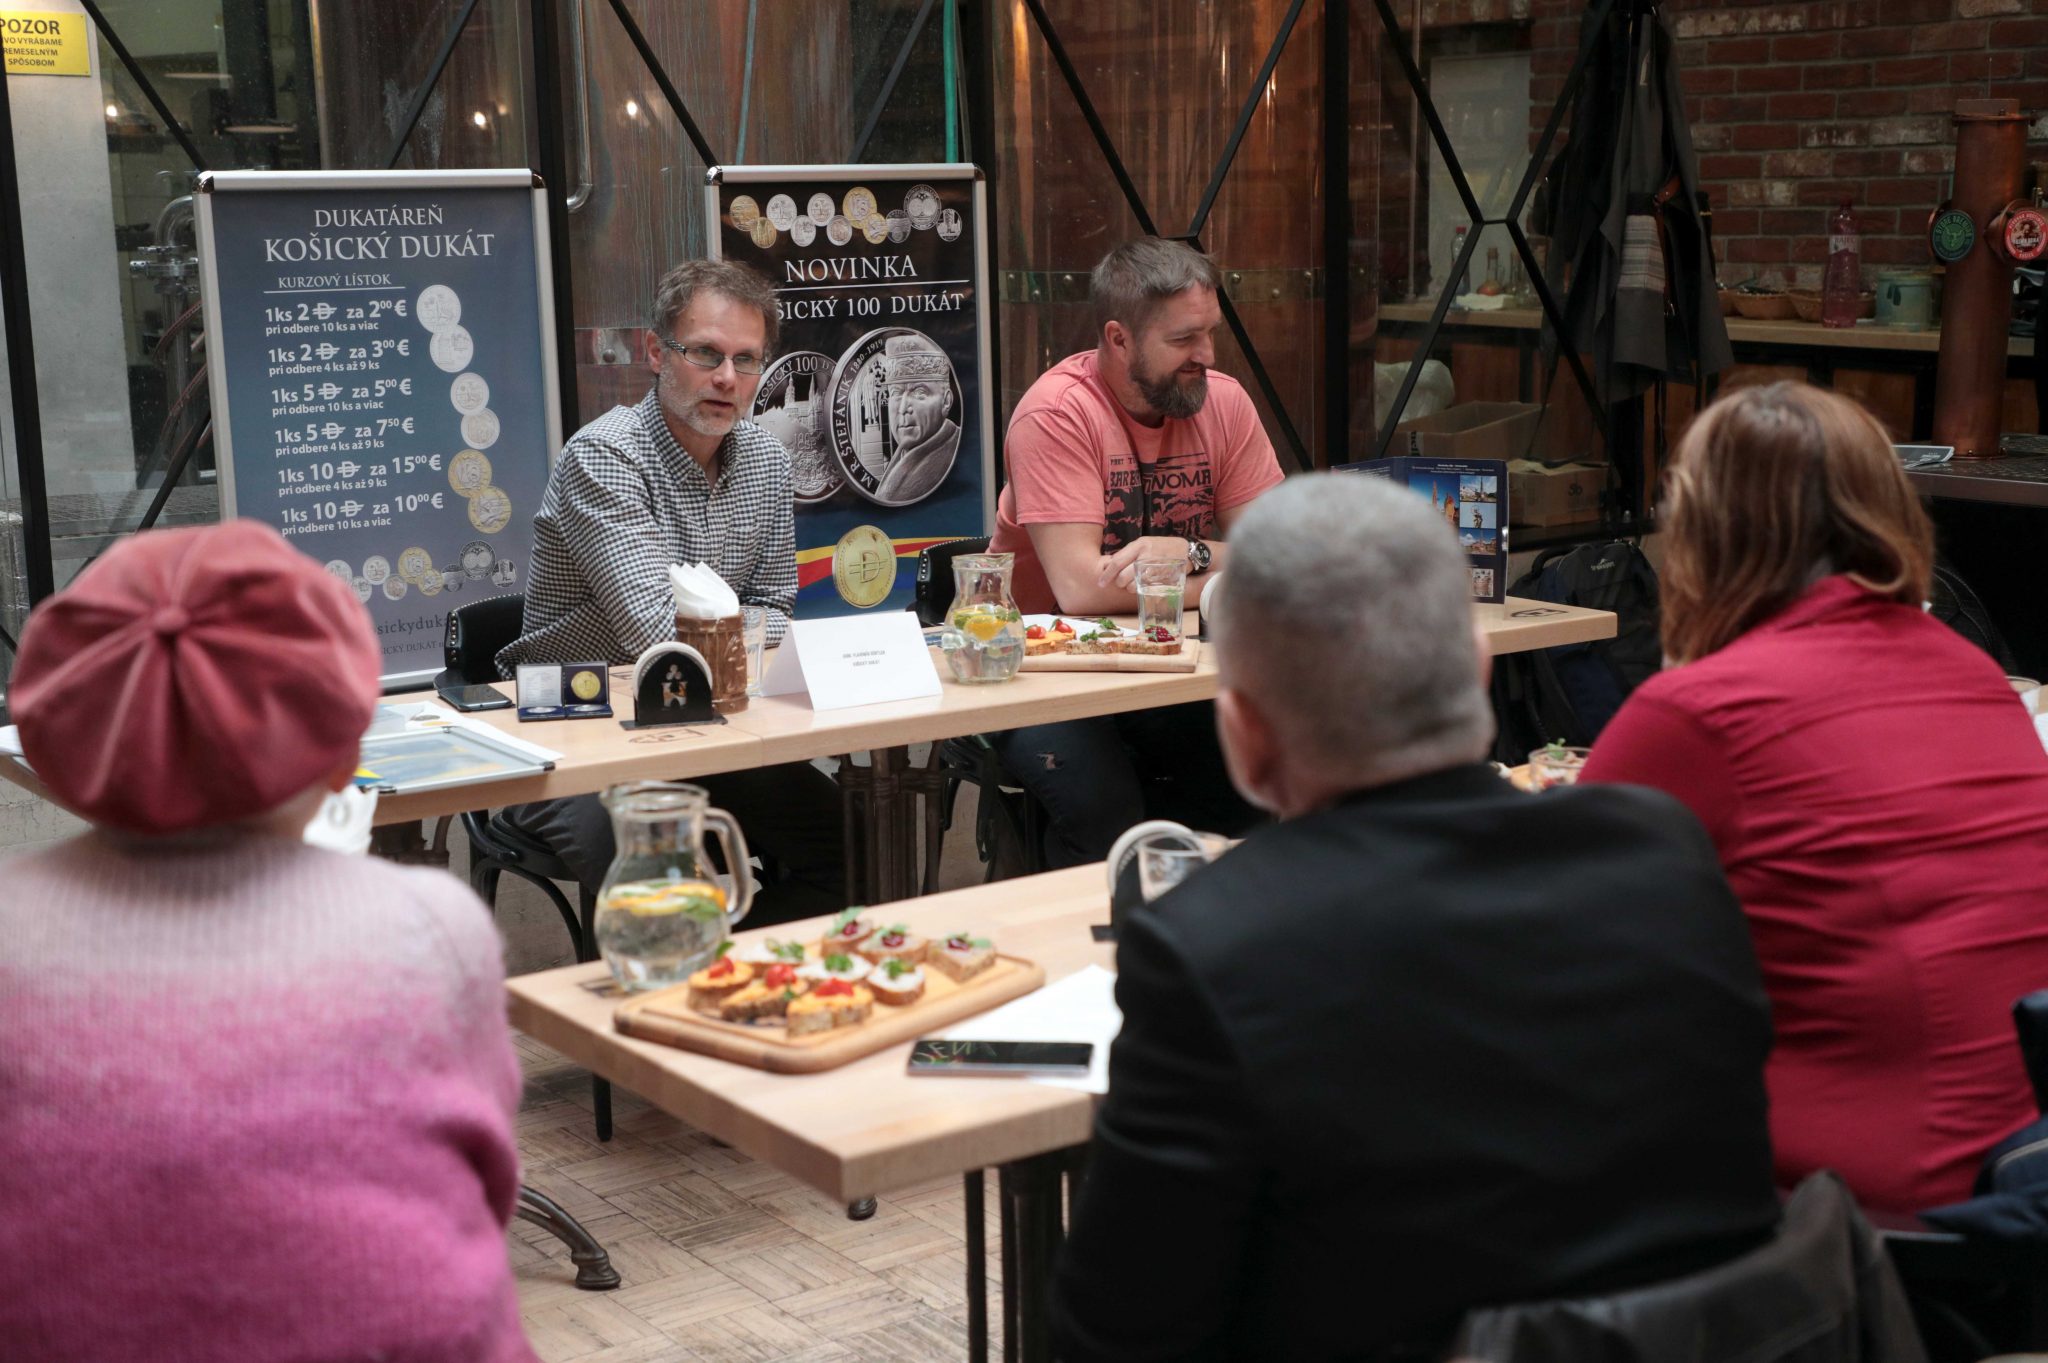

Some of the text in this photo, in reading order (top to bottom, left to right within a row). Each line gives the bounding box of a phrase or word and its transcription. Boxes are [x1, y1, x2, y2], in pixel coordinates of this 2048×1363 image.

[8, 58, 55, 66] SPÔSOBOM
[315, 204, 443, 227] DUKATÁREŇ
[264, 229, 495, 262] KOŠICKÝ DUKÁT
[785, 255, 917, 282] NOVINKA
[279, 273, 392, 288] KURZOVÝ LÍSTOK
[776, 290, 964, 320] ŠICKÝ 100 DUKÁT
[266, 307, 293, 322] 1ks
[347, 307, 364, 319] za
[266, 320, 379, 336] pri odbere 10 ks a viac
[269, 349, 296, 363] 1ks
[349, 346, 367, 359] za
[269, 360, 379, 377] pri odbere 4 ks až 9 ks
[796, 356, 818, 372] 100
[272, 389, 298, 403] 1ks
[352, 387, 370, 399] za
[272, 400, 384, 417] pri odbere 10 ks a viac
[275, 429, 301, 443] 1ks
[355, 426, 372, 439] za
[275, 439, 384, 457] pri odbere 4 ks až 9 ks
[278, 469, 305, 484] 1ks
[370, 464, 387, 476] za
[278, 478, 387, 497] pri odbere 4 ks až 9 ks
[282, 509, 308, 523] 1ks
[373, 503, 390, 515] za
[282, 517, 392, 537] pri odbere 10 ks a viac
[377, 614, 448, 635] sickyduk
